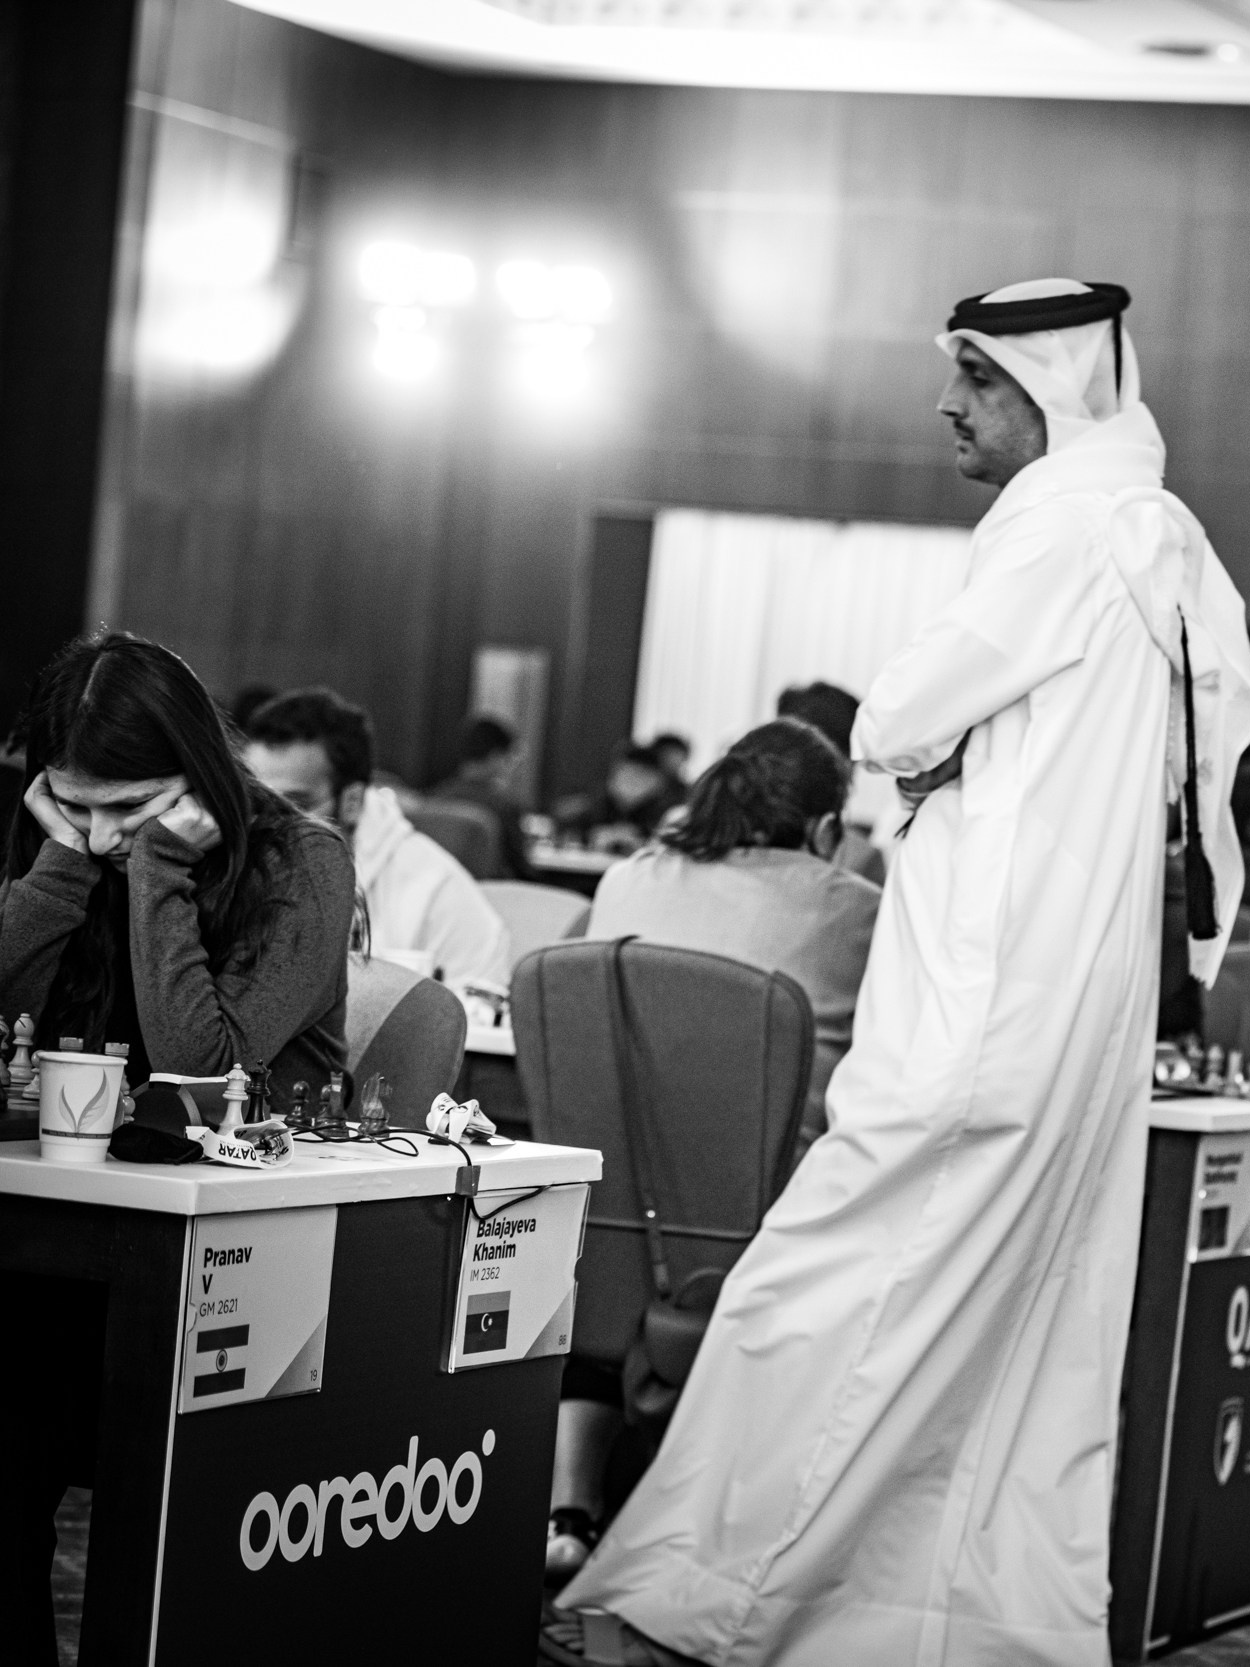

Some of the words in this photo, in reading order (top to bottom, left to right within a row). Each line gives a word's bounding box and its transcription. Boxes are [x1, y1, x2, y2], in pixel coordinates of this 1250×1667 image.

[218, 1142, 257, 1161] QATAR
[476, 1217, 537, 1240] Balajayeva
[203, 1246, 253, 1269] Pranav
[472, 1240, 517, 1262] Khanim
[202, 1273, 214, 1295] V
[469, 1269, 480, 1282] IM
[480, 1266, 501, 1281] 2362
[199, 1302, 215, 1317] GM
[217, 1298, 238, 1315] 2621
[309, 1369, 318, 1382] 19
[240, 1433, 484, 1571] ooredoo
